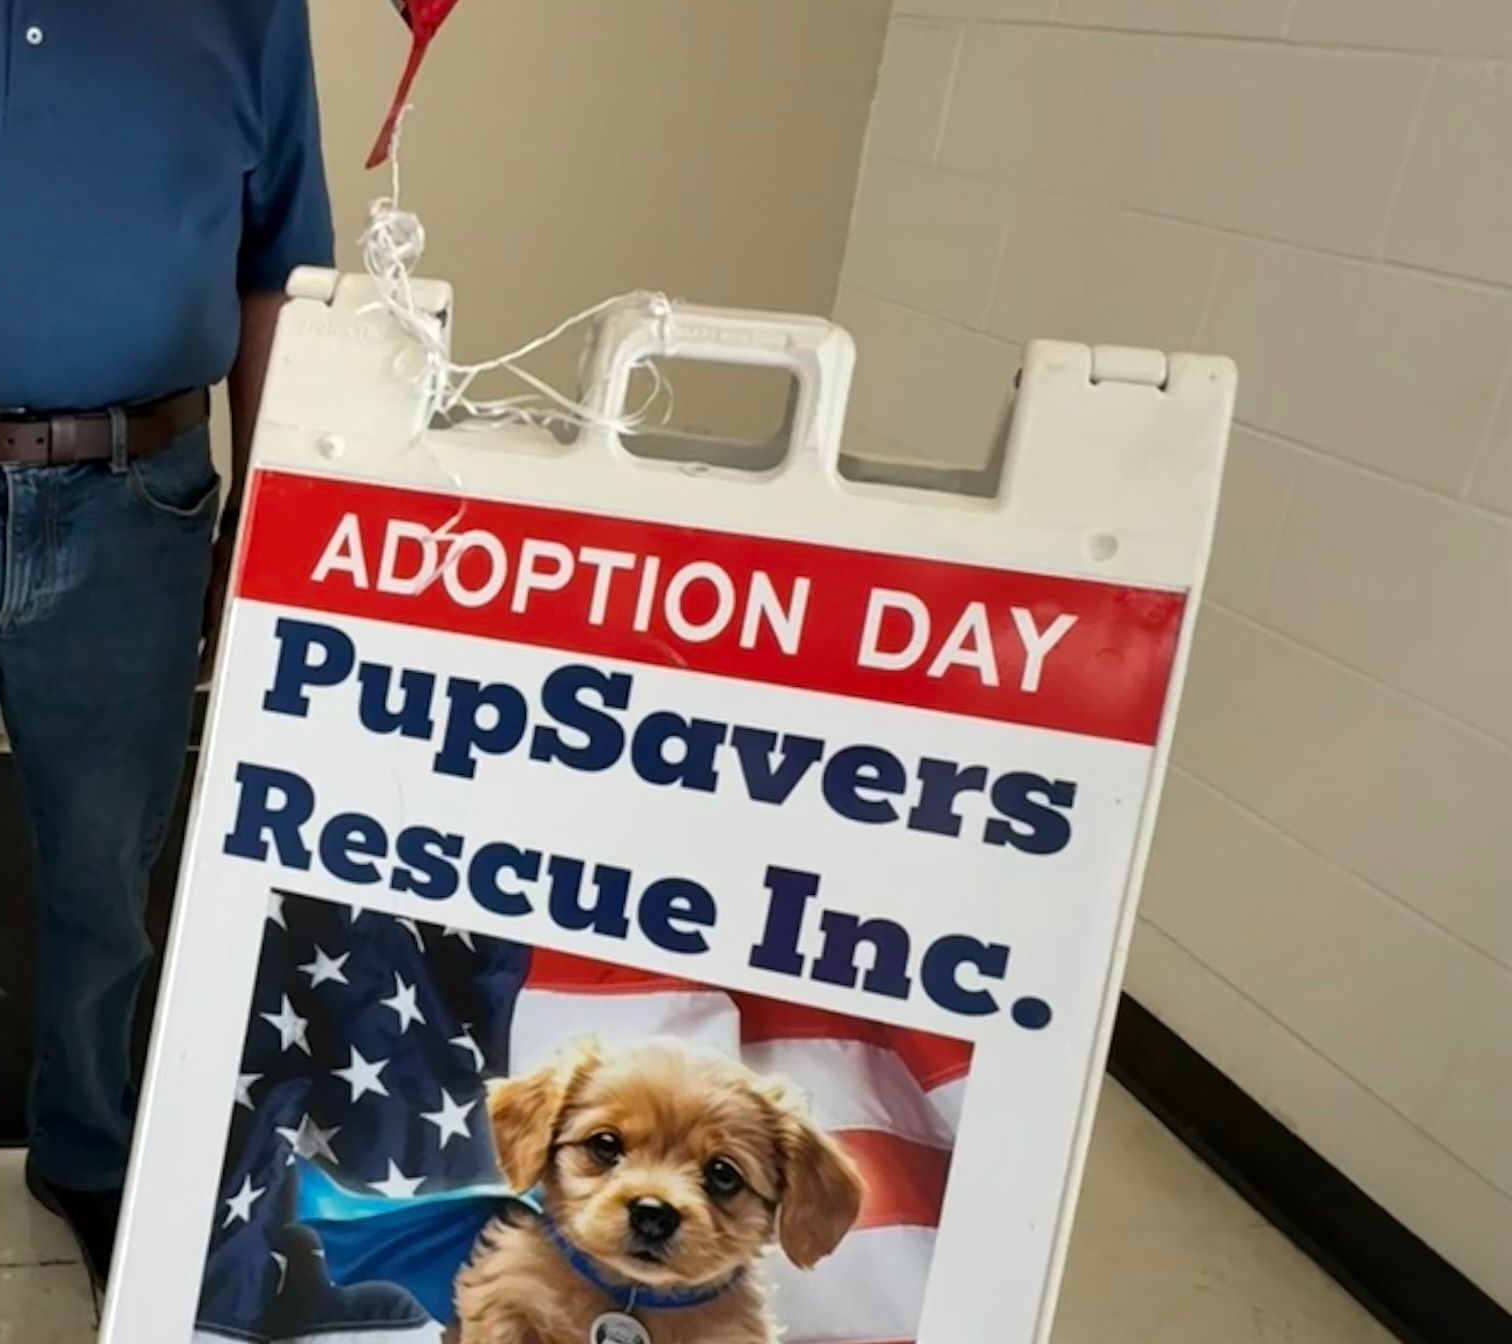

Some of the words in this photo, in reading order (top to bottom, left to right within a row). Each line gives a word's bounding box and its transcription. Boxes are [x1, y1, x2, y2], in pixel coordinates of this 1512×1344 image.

[312, 515, 809, 654] ADOPTION
[859, 589, 1076, 691] DAY
[263, 618, 1077, 855] PupSavers
[224, 762, 716, 954] Rescue
[749, 865, 1051, 1029] Inc.
